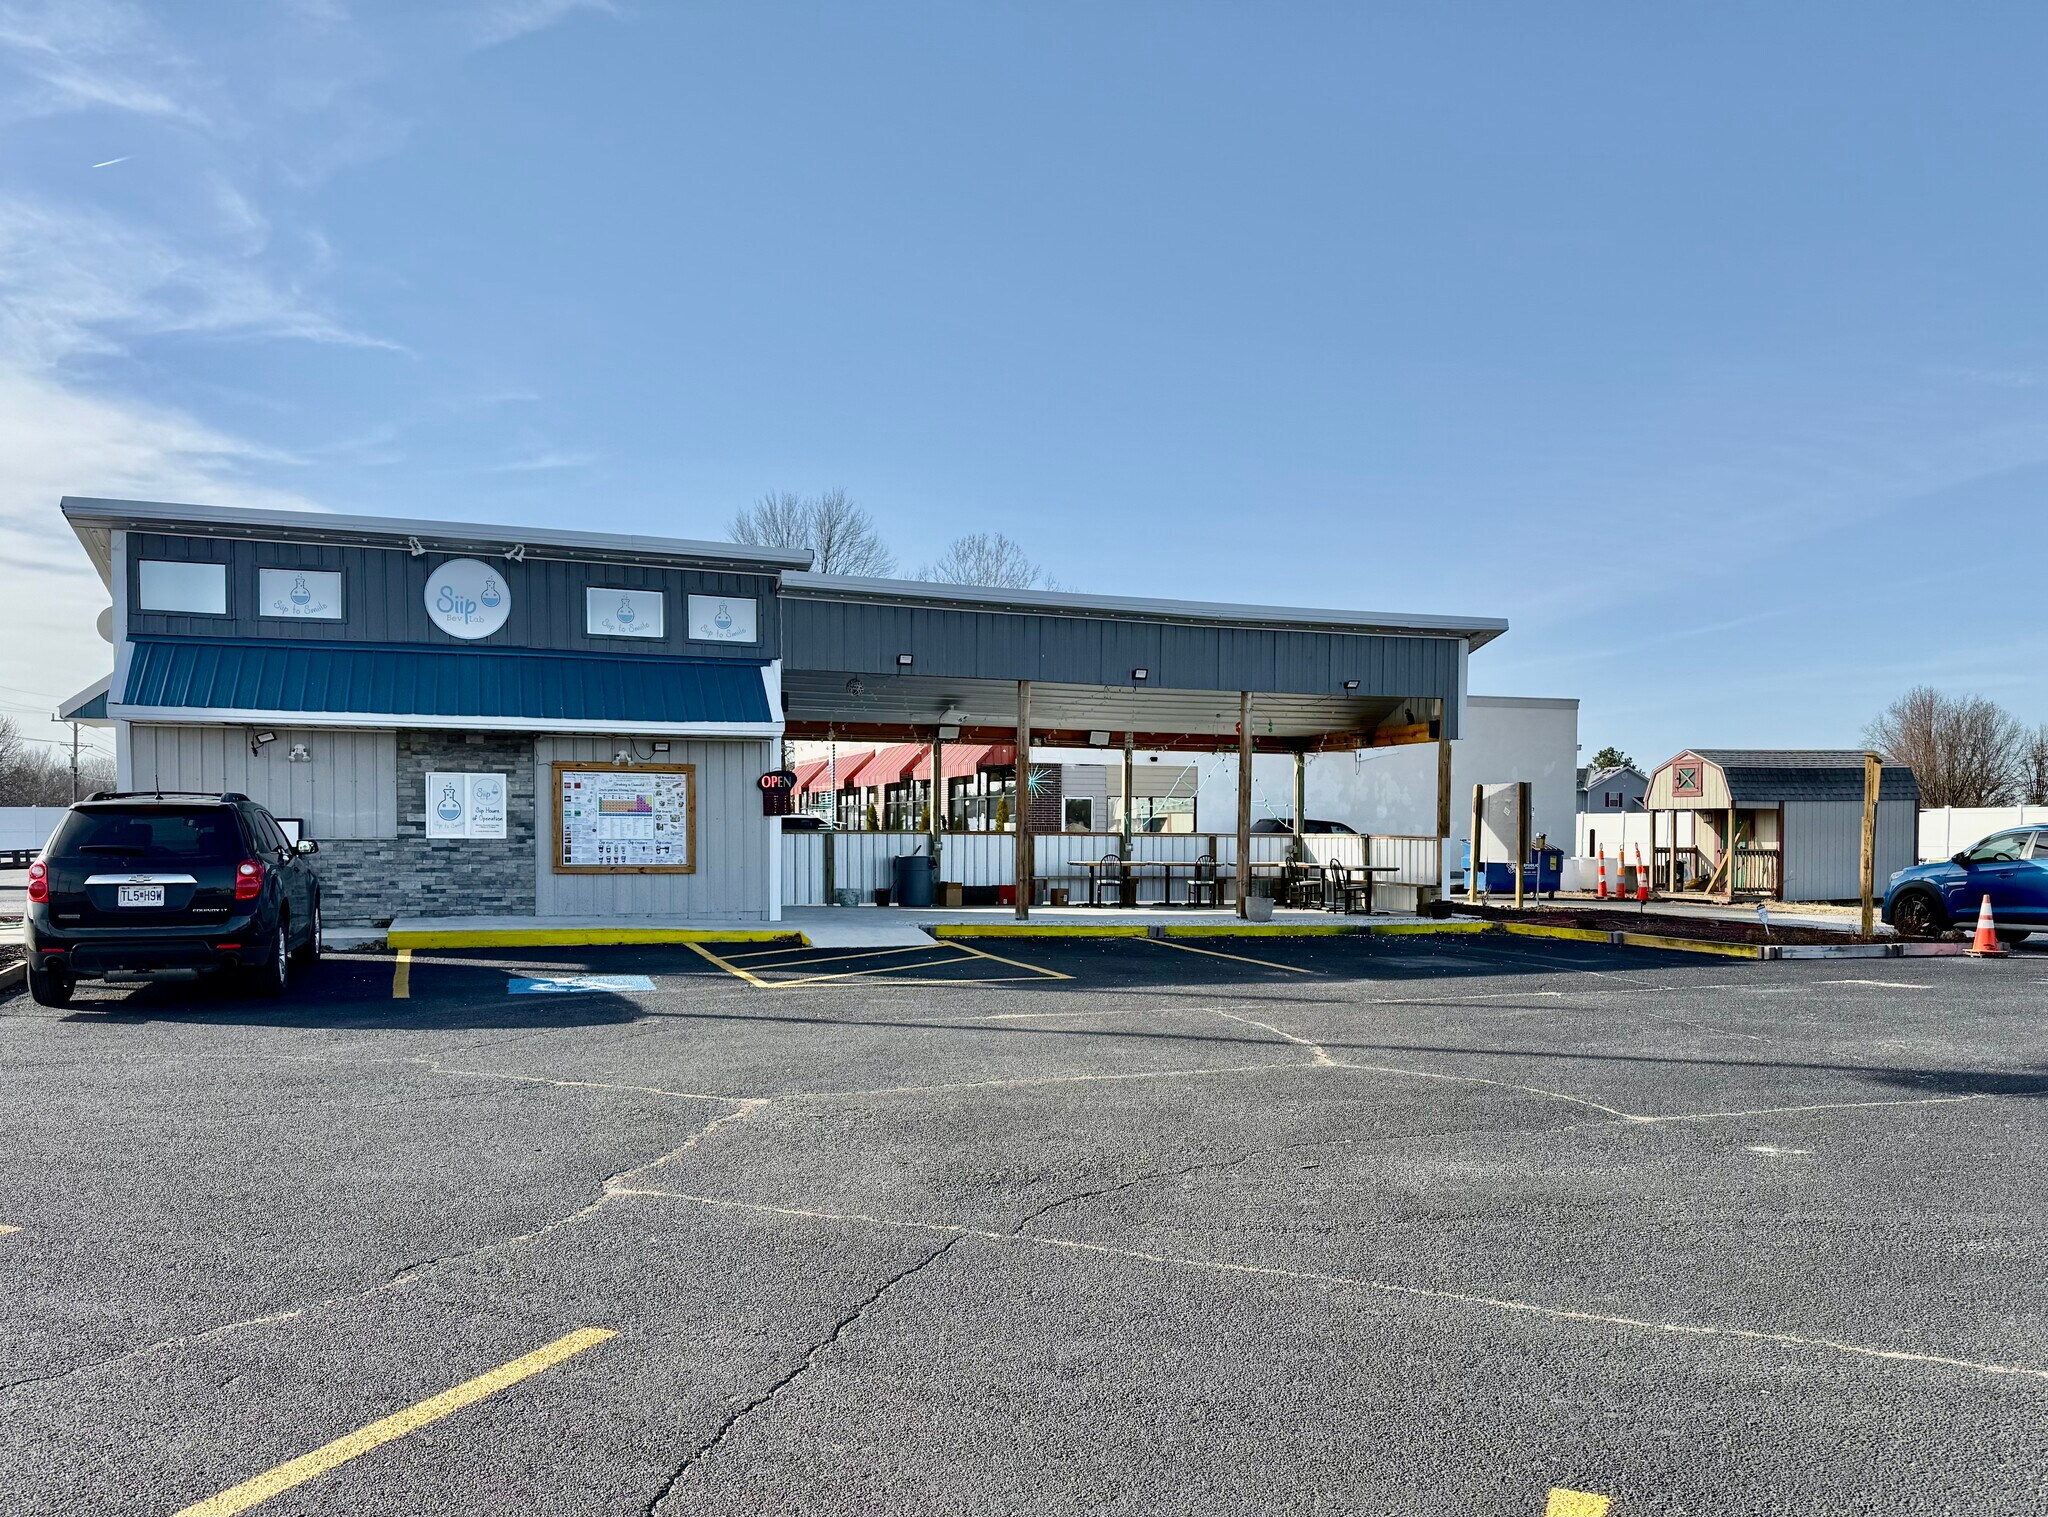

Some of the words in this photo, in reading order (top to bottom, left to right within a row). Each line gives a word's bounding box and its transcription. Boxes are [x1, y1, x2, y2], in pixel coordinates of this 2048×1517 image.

[292, 604, 301, 615] to
[304, 601, 328, 615] Smile
[436, 585, 477, 625] Siip
[446, 614, 463, 622] Bev
[469, 615, 485, 623] Lab
[761, 775, 792, 788] OPEN
[479, 814, 503, 823] Operation
